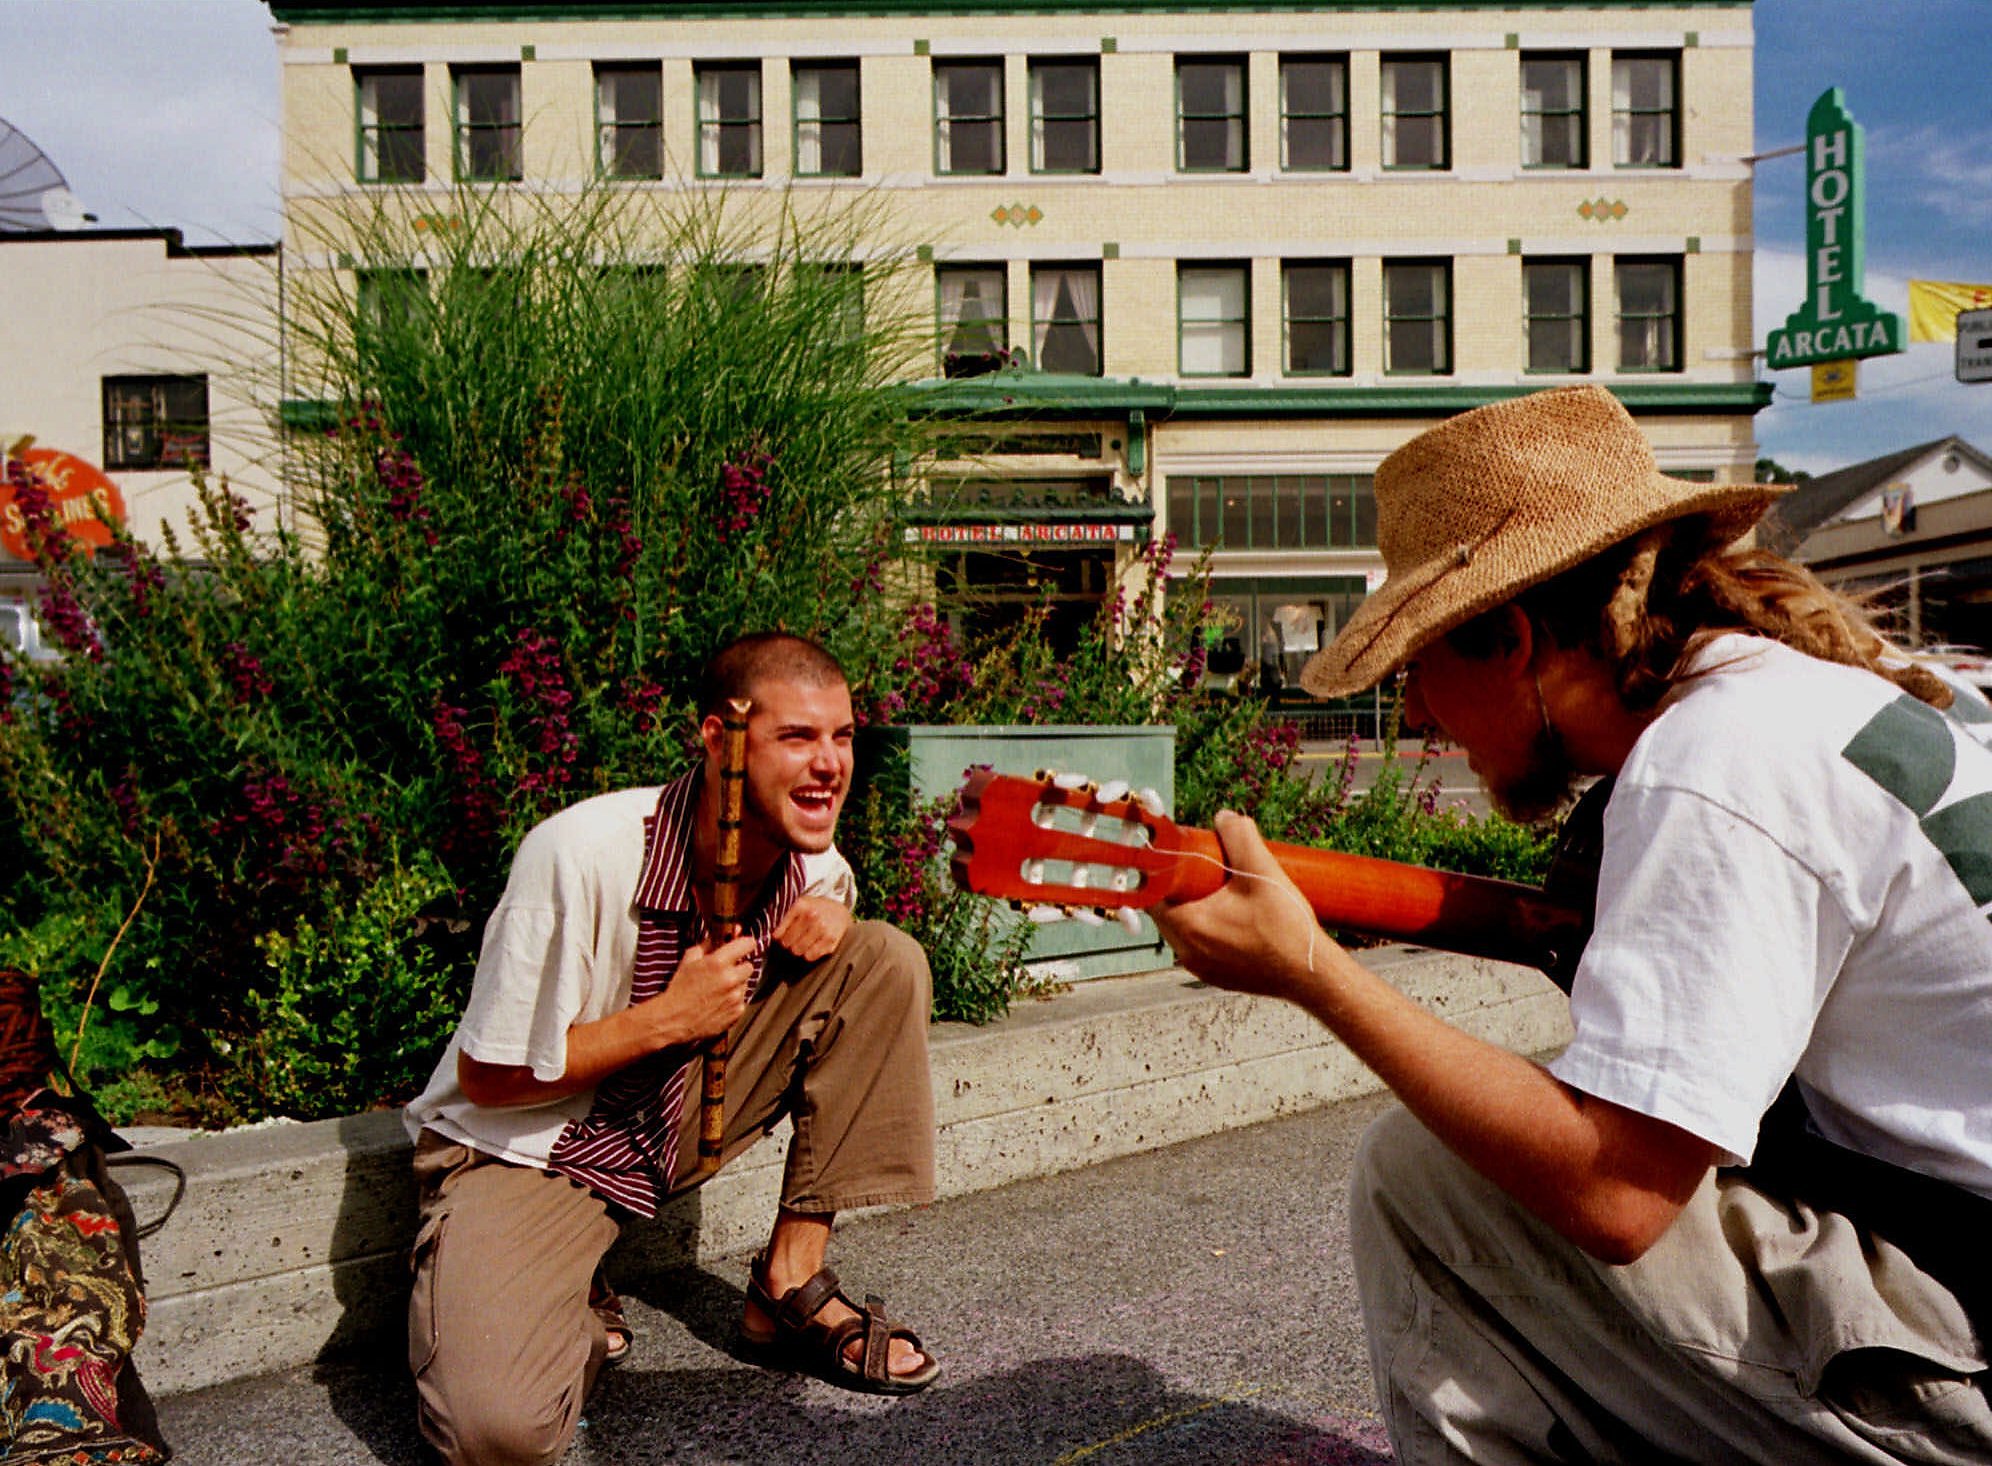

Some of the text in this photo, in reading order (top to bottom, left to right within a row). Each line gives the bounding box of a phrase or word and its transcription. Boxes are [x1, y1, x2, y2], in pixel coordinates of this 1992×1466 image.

[1811, 130, 1849, 322] HOTEL
[1774, 320, 1889, 361] ARCATA
[921, 524, 1118, 542] HOTEL ARCATA
